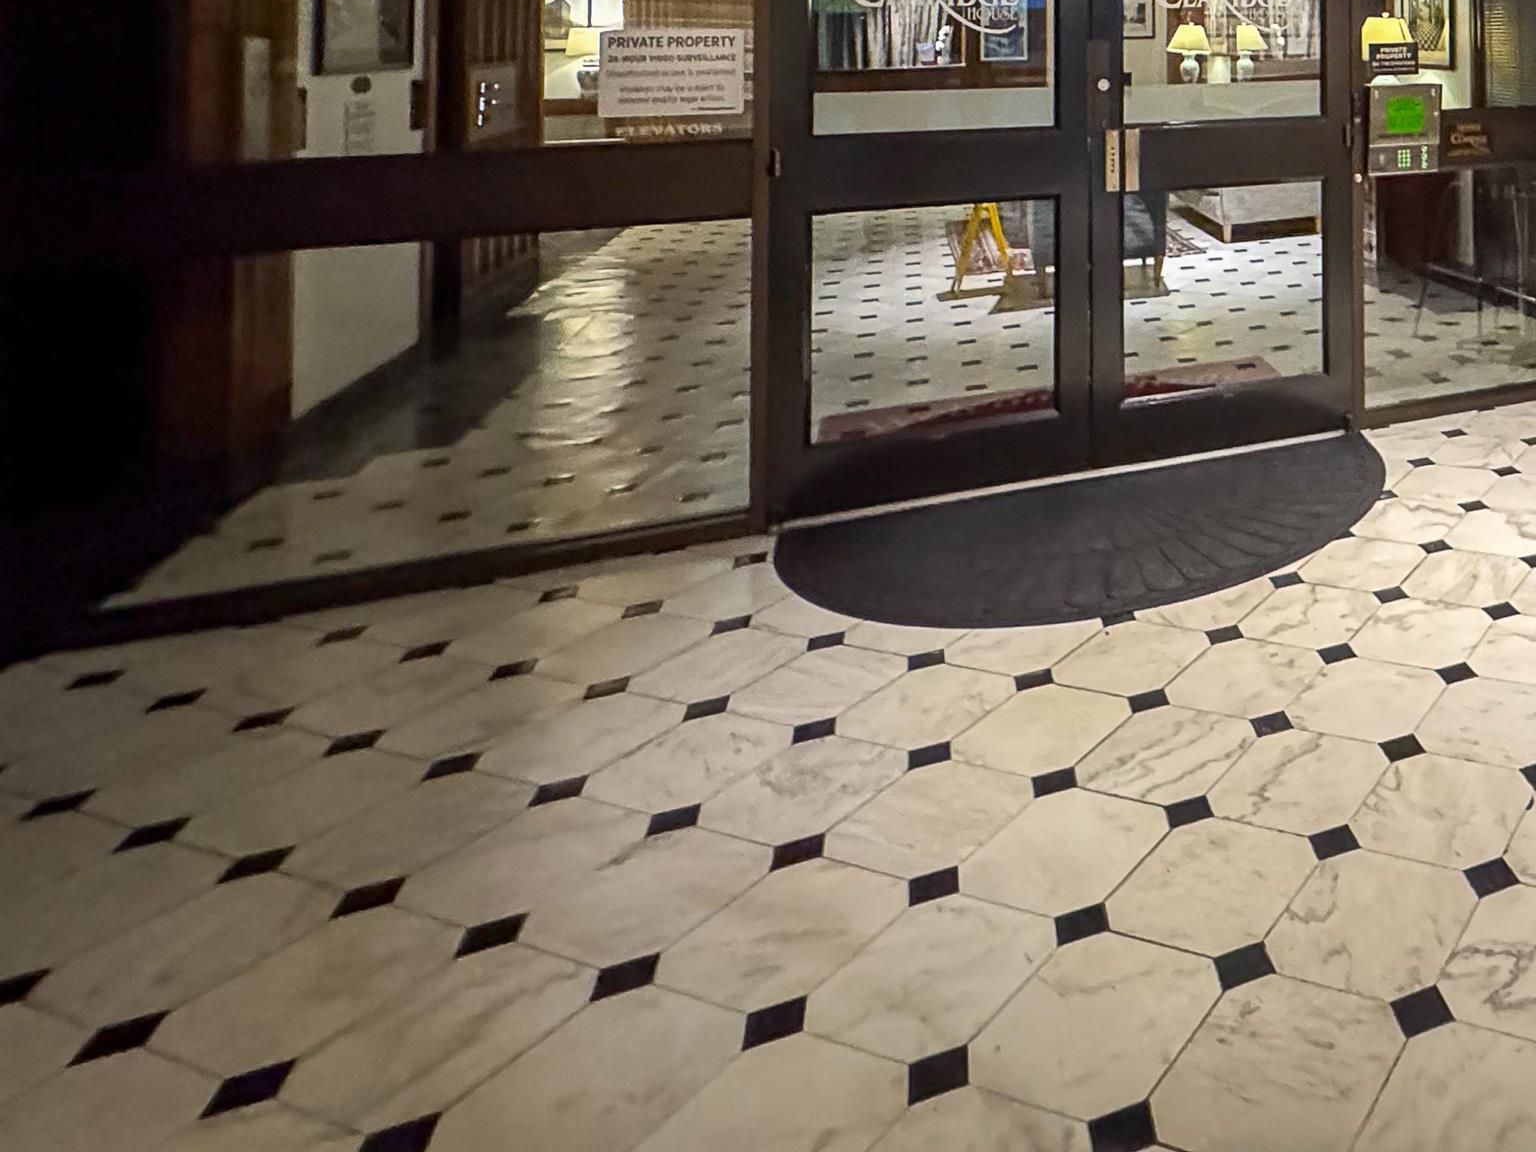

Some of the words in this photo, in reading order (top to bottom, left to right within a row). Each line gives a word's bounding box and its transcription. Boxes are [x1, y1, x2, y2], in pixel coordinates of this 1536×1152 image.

[966, 6, 1019, 21] HOUSE
[607, 35, 664, 49] PRIVATE
[667, 35, 736, 48] PROPERTY
[614, 122, 723, 137] ELEVATORS
